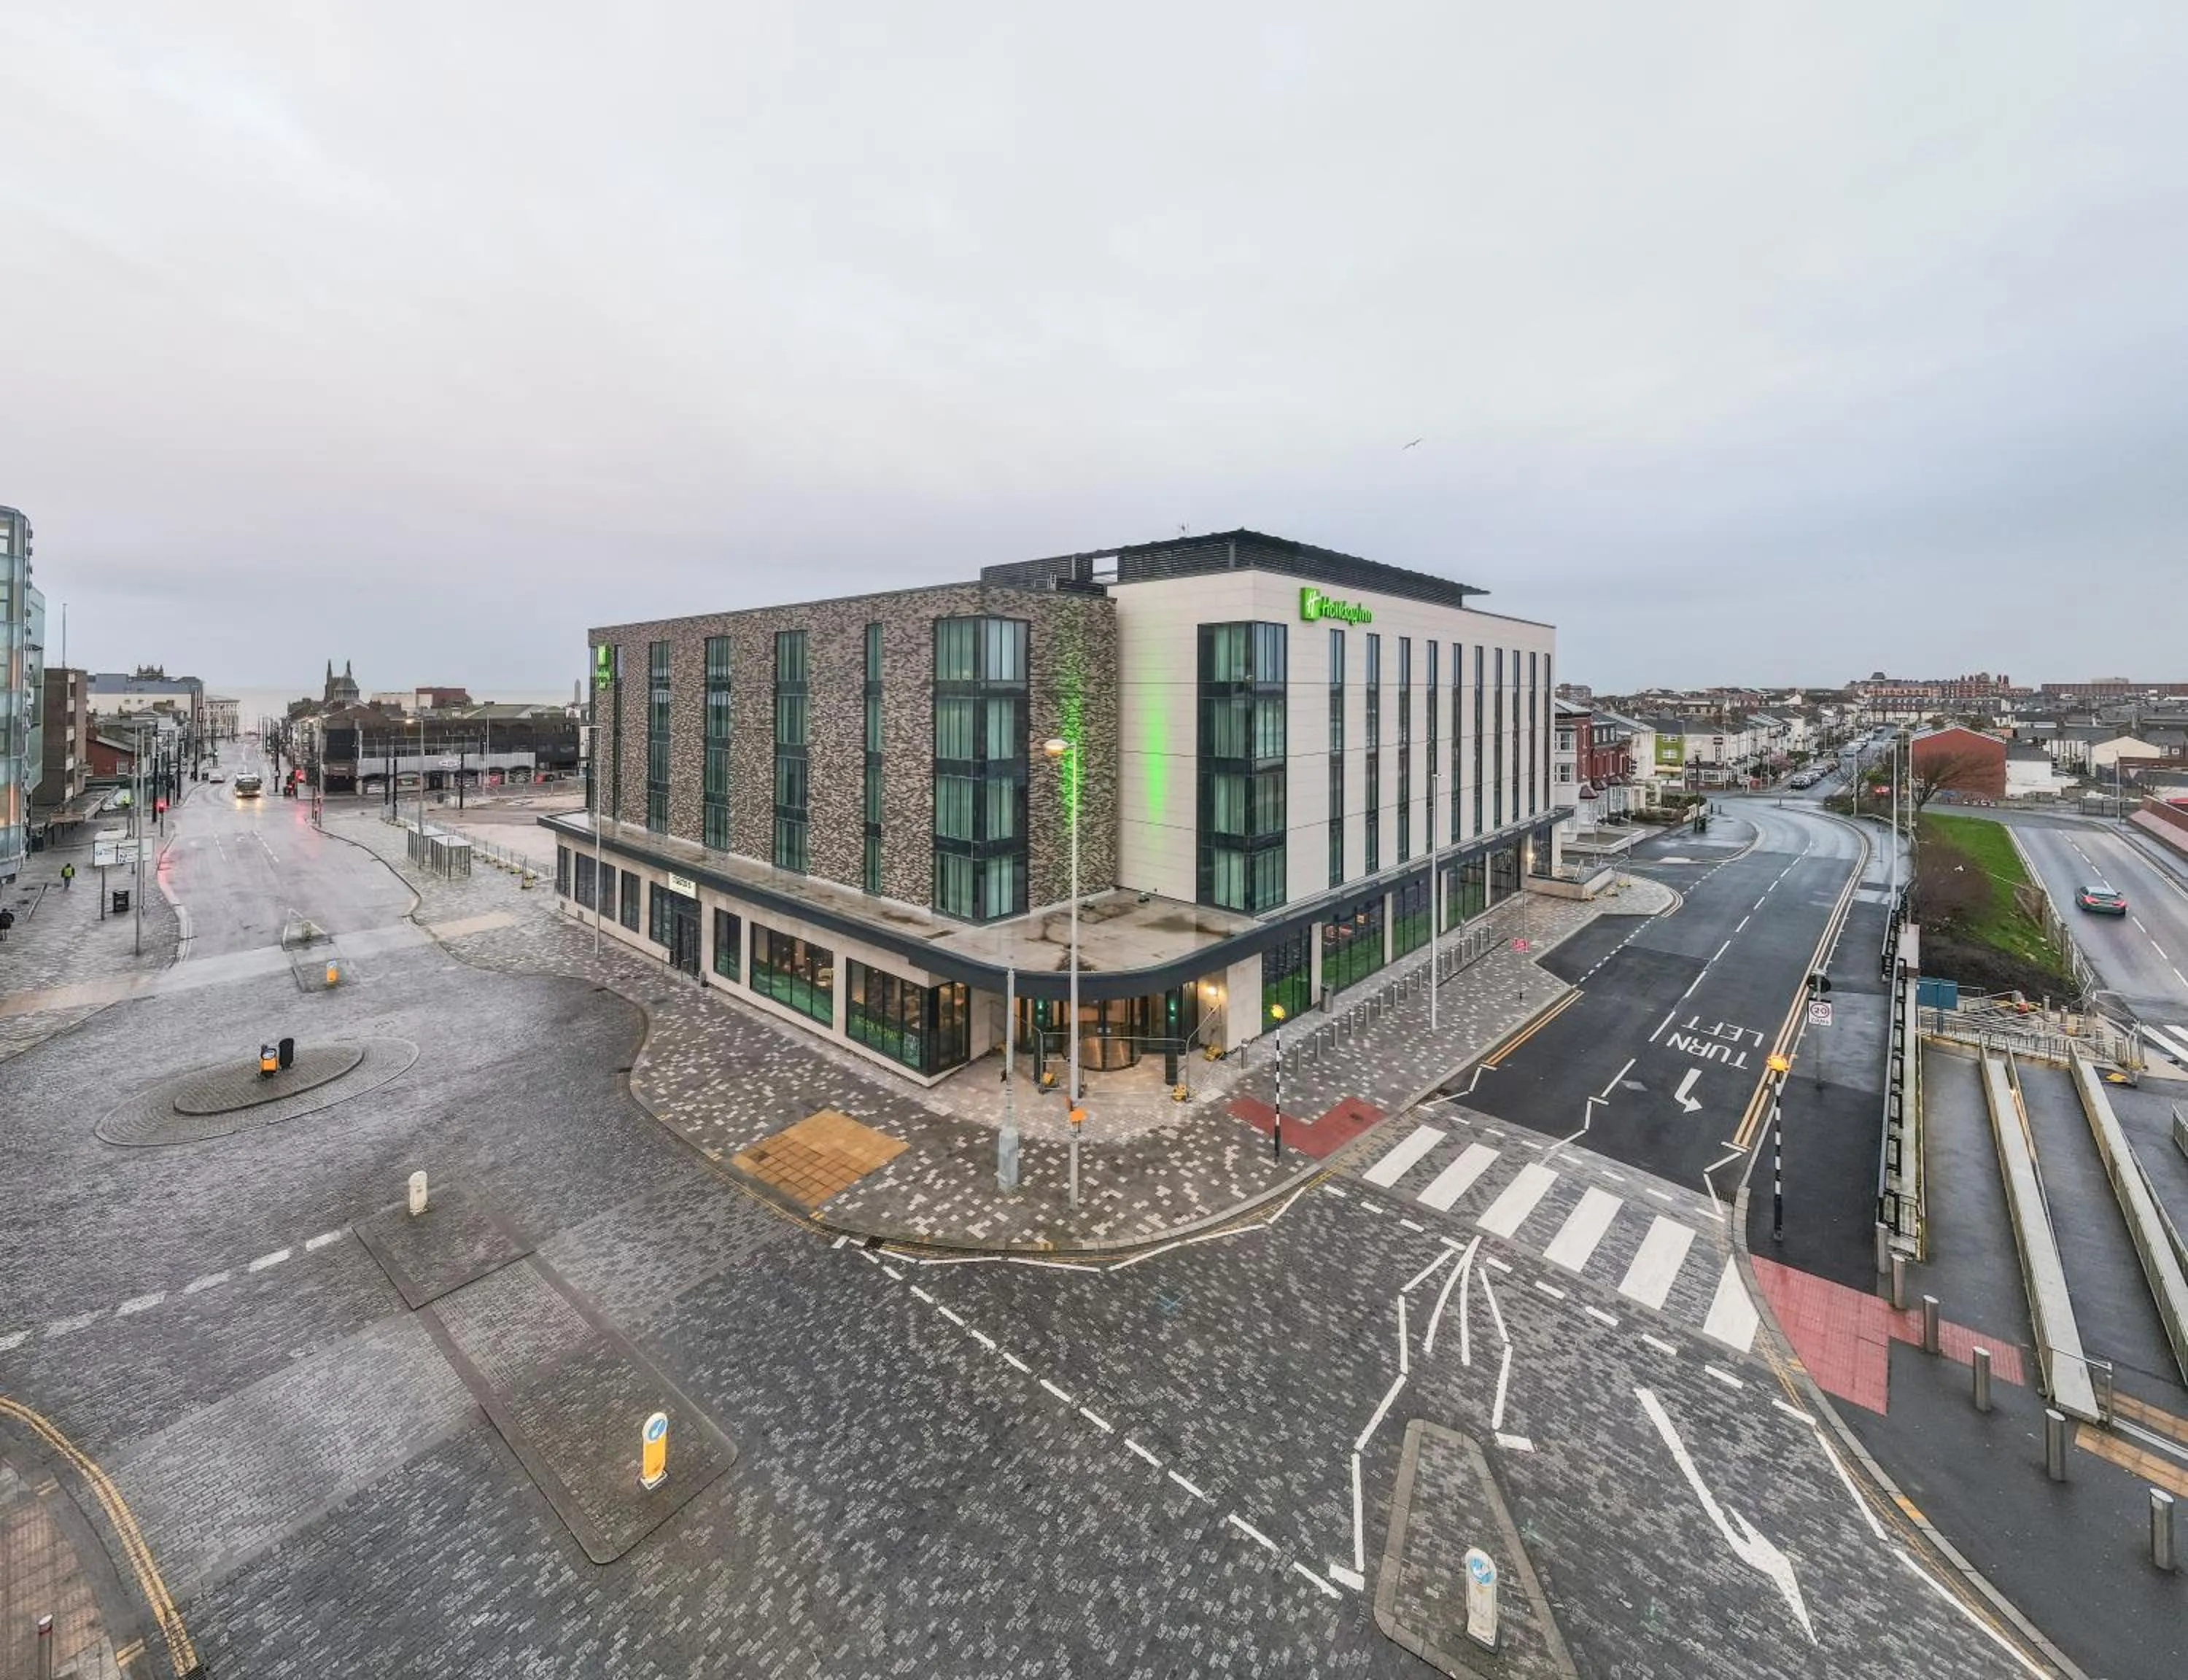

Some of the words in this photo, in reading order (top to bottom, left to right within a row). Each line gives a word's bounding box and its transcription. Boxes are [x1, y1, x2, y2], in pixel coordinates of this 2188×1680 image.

[1813, 1006, 1827, 1014] 20
[1681, 1016, 1764, 1048] LEFT
[1667, 1032, 1748, 1069] TURN
